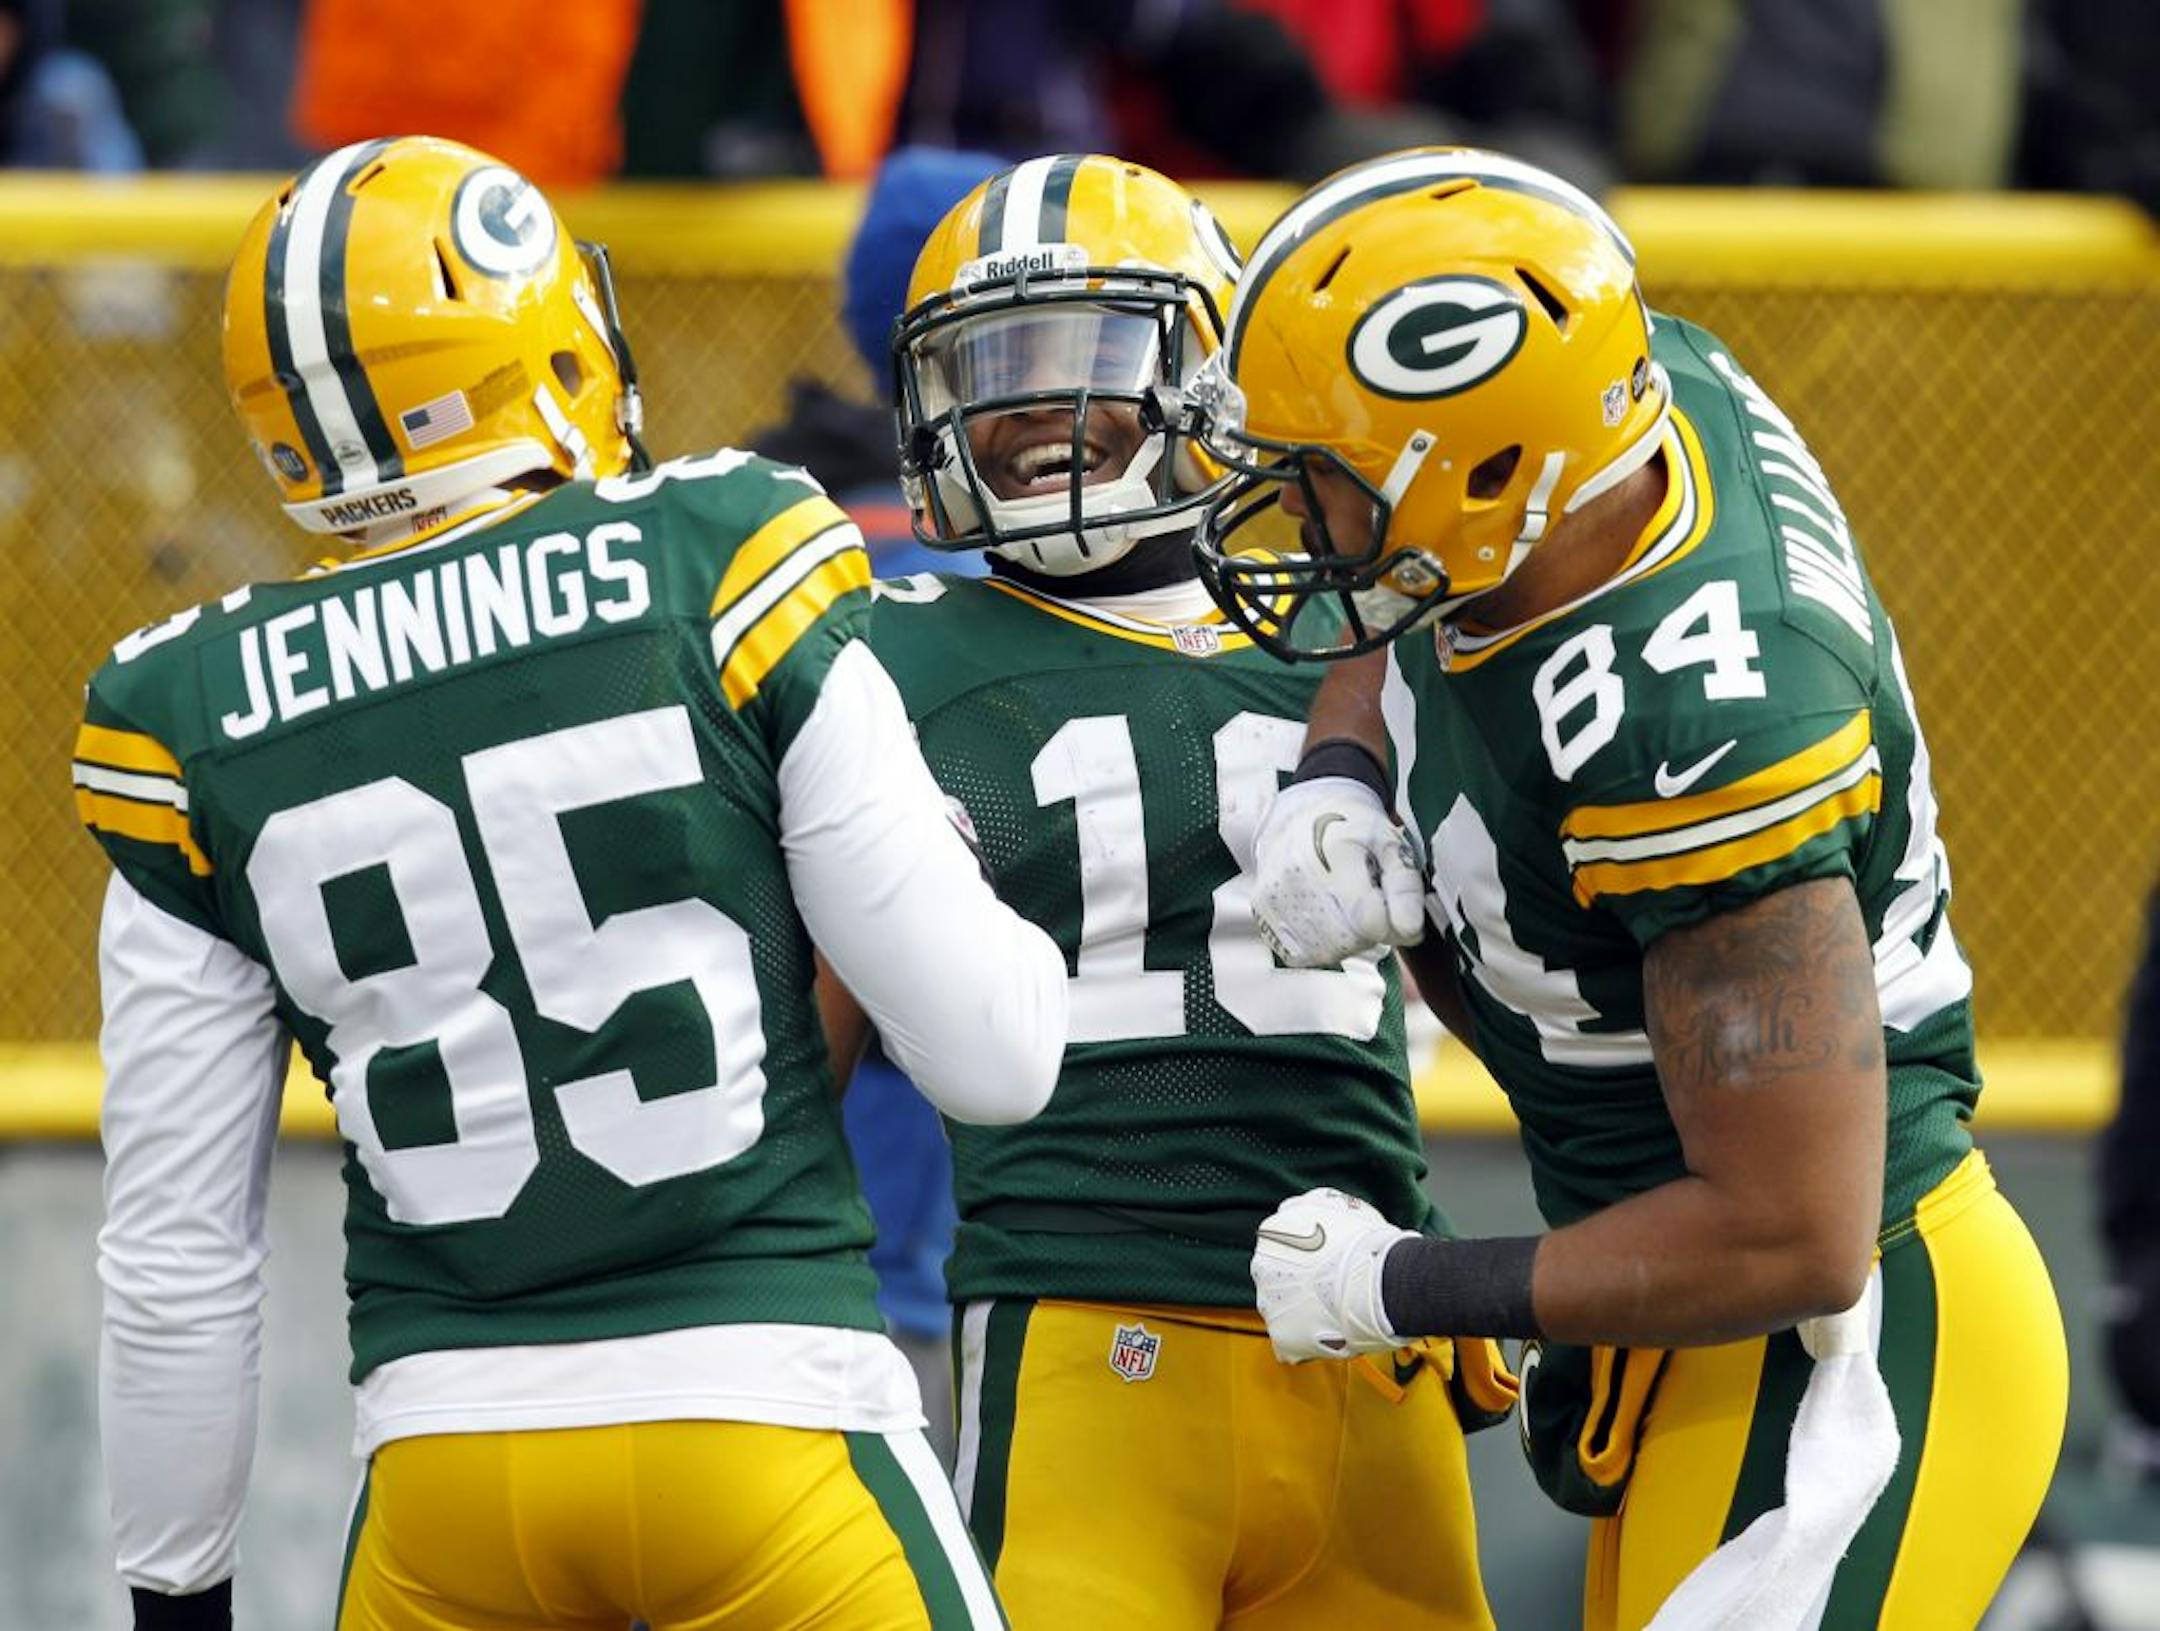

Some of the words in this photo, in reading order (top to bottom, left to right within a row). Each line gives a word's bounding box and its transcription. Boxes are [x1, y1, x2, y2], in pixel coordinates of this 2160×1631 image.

[454, 164, 557, 278] G
[986, 251, 1055, 279] Riddell
[1350, 275, 1527, 396] G
[320, 488, 418, 527] PACKERS
[220, 521, 652, 740] JENNINGS
[1181, 634, 1215, 650] NFL
[1531, 580, 1768, 782] 84
[1030, 710, 1387, 1042] 18
[246, 704, 768, 1225] 85
[1116, 1346, 1146, 1373] NFL
